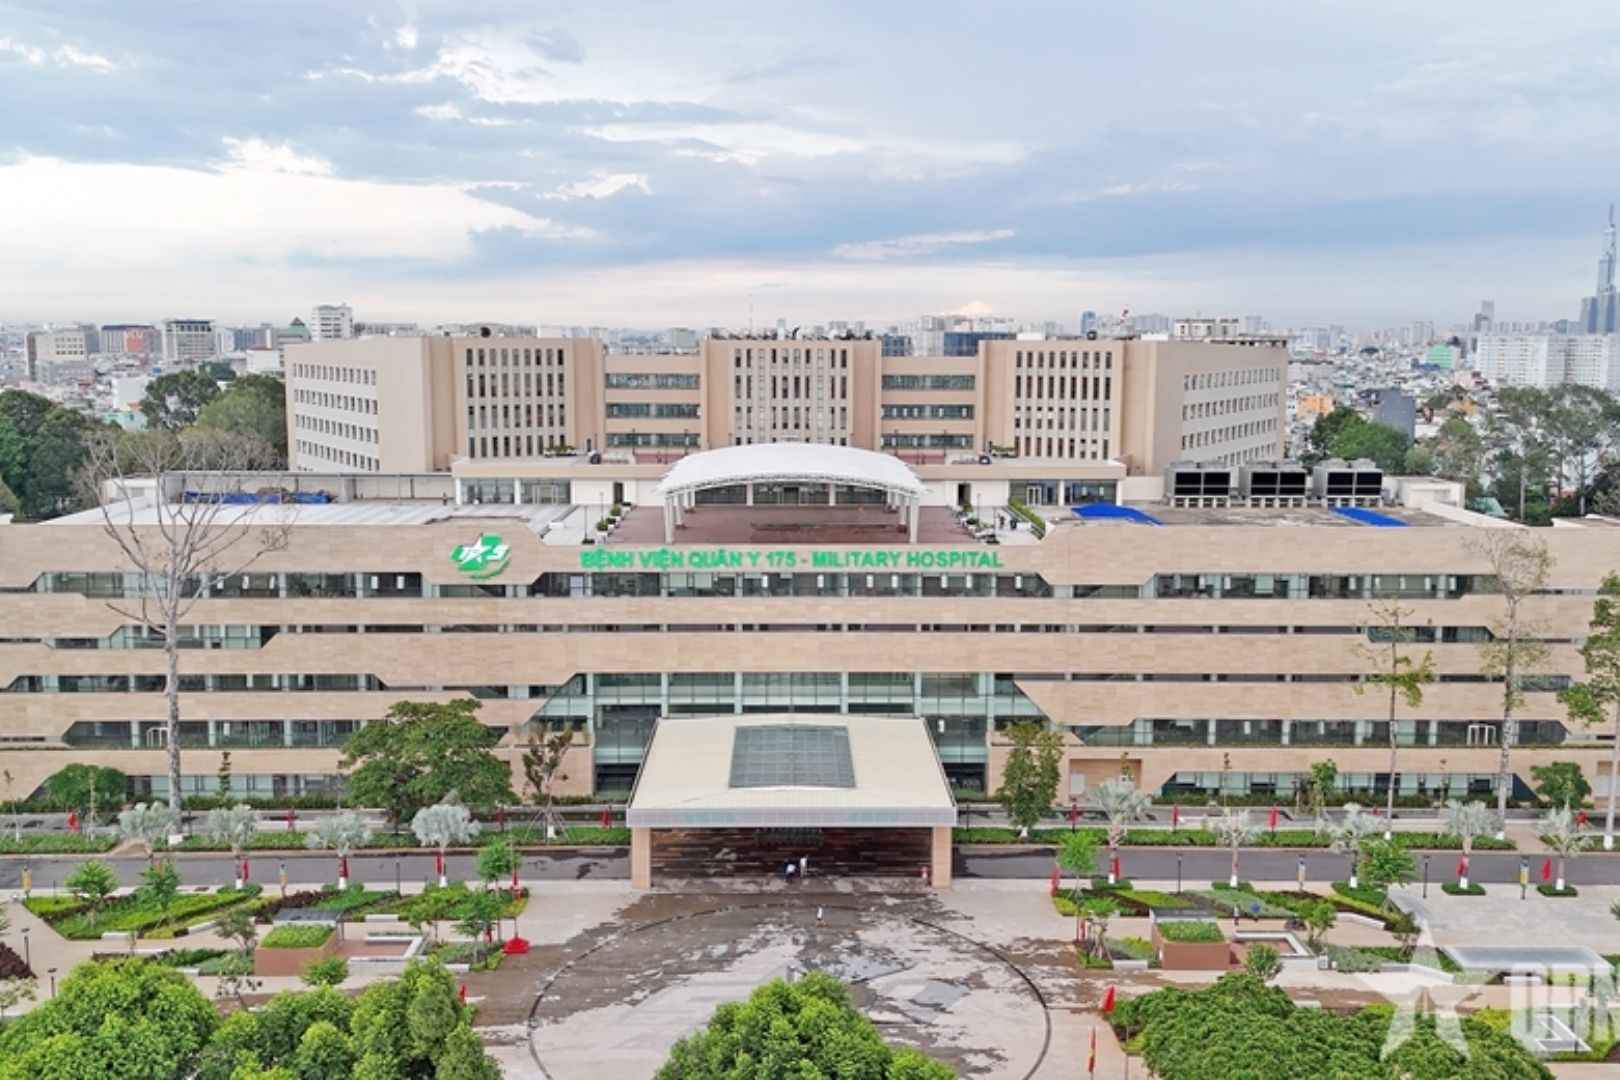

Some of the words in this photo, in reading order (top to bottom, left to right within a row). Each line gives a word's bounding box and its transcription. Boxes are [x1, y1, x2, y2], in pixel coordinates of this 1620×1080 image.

[580, 545, 635, 571] BỆNH
[639, 546, 684, 571] VIỆN
[688, 548, 742, 569] QUÂN
[747, 550, 761, 567] Y
[766, 550, 797, 568] 175
[811, 550, 901, 567] MILITARY
[906, 550, 1004, 567] HOSPITAL
